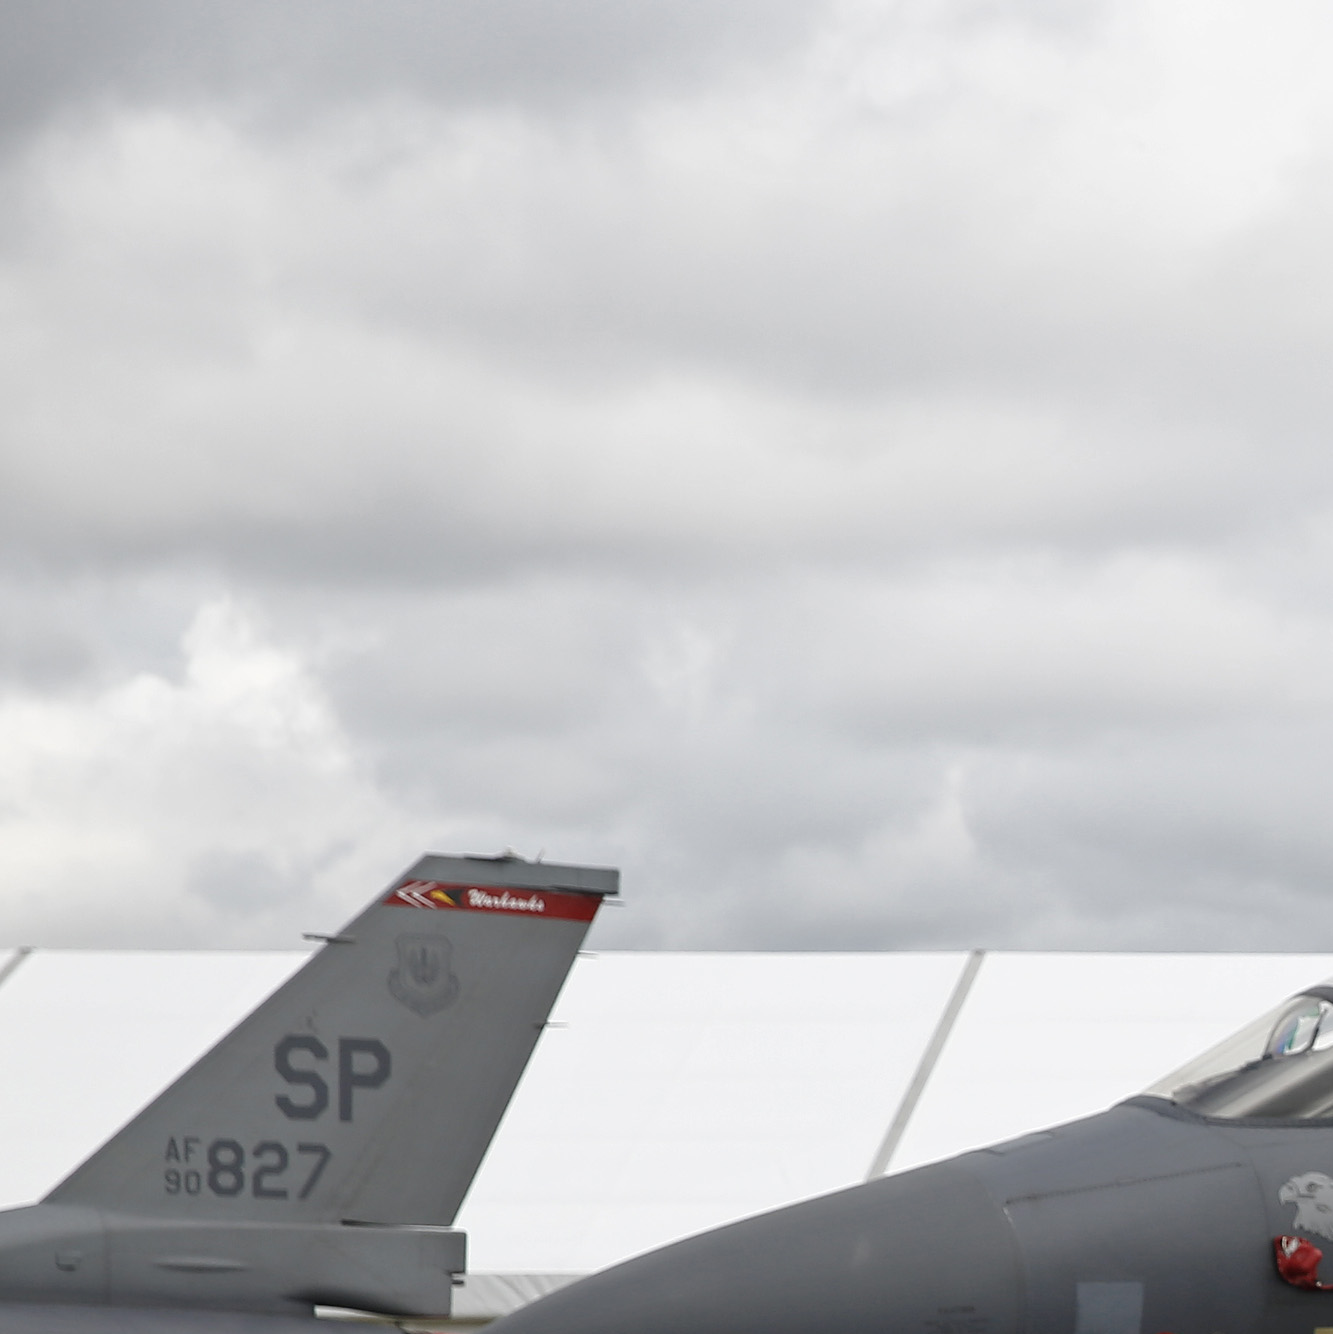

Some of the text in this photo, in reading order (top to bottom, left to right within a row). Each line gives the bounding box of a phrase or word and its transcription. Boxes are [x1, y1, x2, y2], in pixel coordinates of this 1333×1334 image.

[274, 1035, 392, 1122] SP
[165, 1137, 201, 1162] AF
[207, 1138, 332, 1199] 827
[164, 1169, 201, 1195] 90
